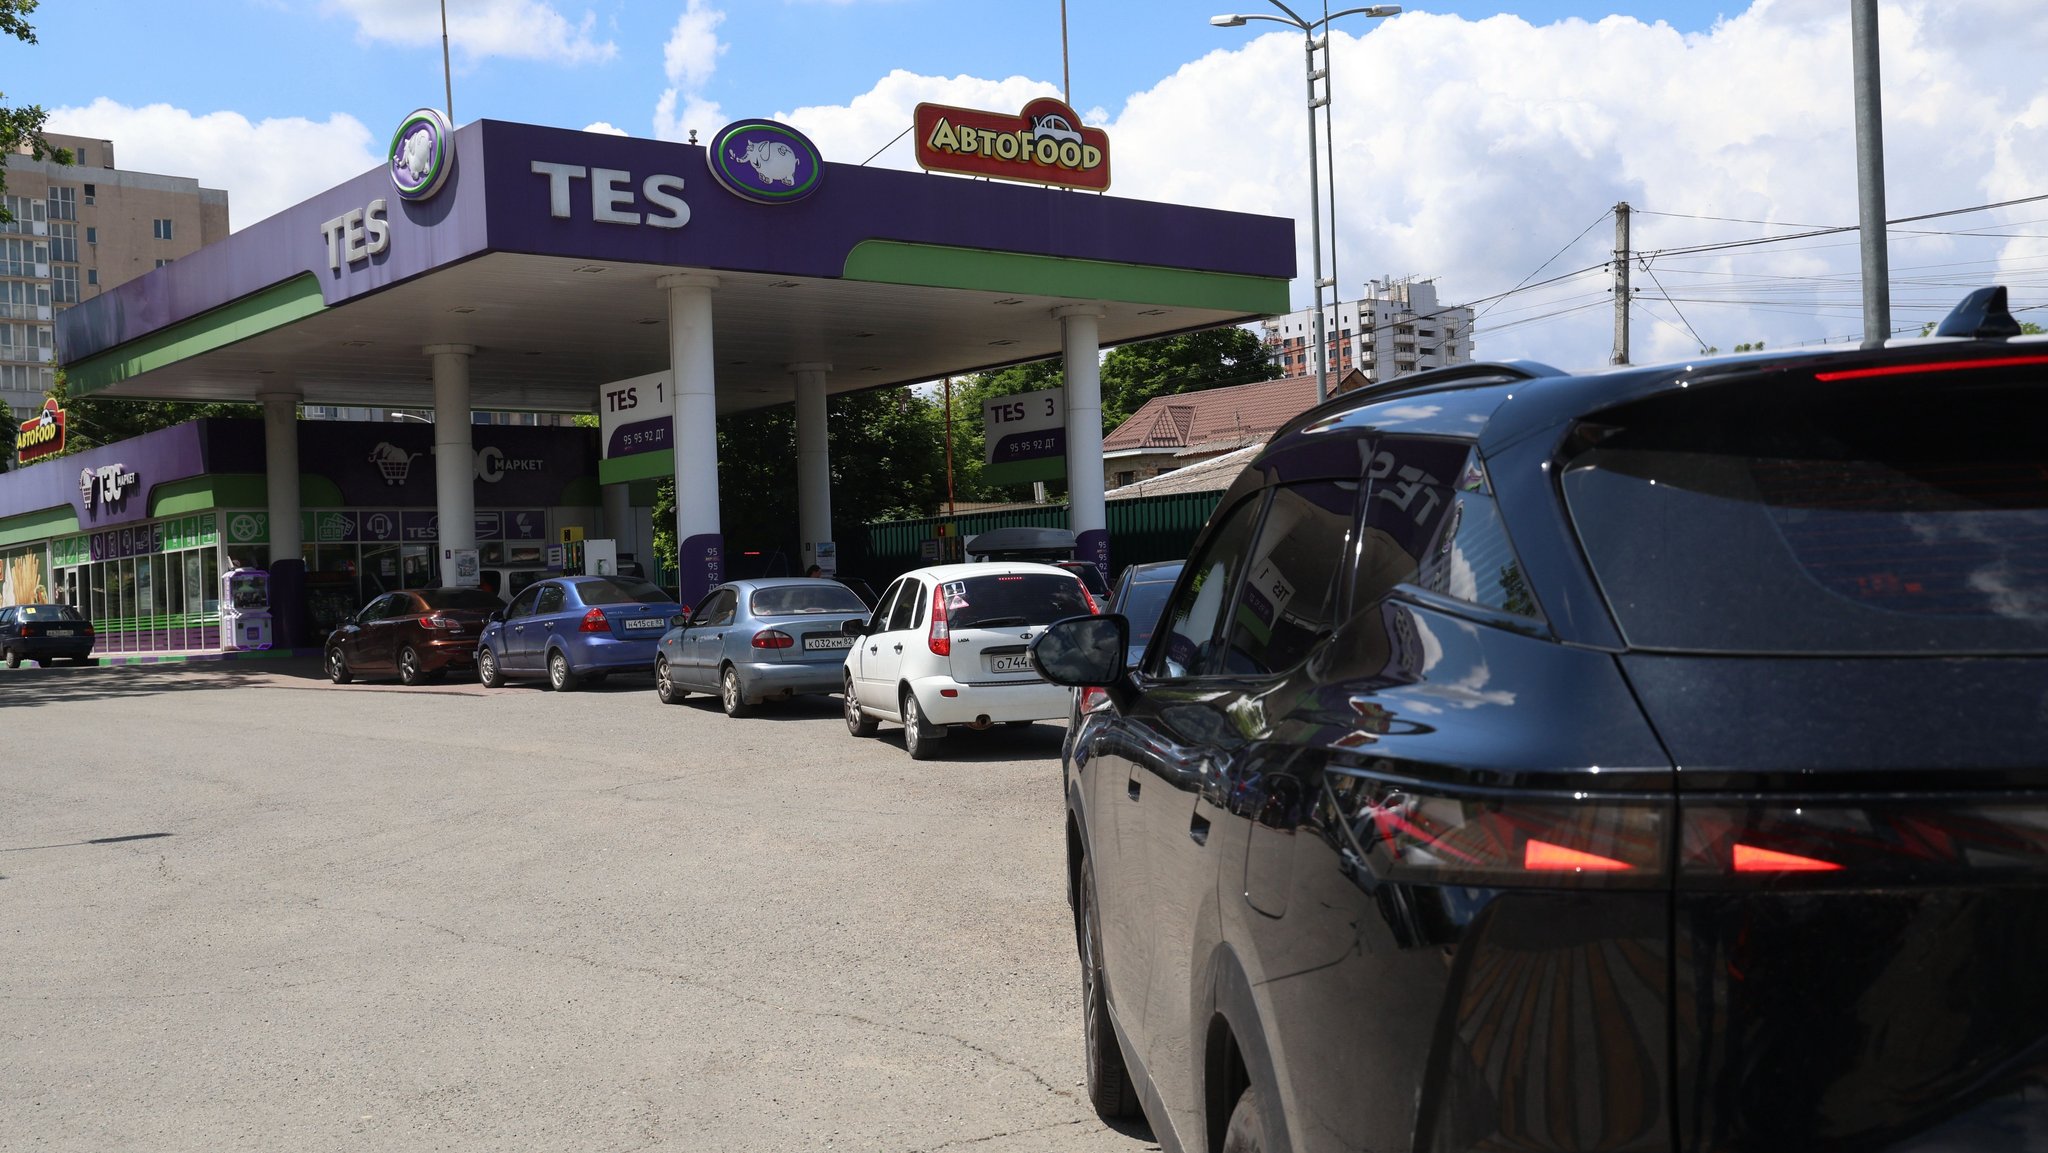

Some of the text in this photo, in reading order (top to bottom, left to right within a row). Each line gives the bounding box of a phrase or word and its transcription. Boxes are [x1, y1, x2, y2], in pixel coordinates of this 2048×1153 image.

[531, 160, 691, 229] TES
[321, 198, 390, 270] TES
[607, 382, 663, 412] TES 1
[990, 398, 1054, 424] TES 3
[623, 428, 665, 445] 95 95 92 ДТ
[1010, 438, 1055, 452] 95 95 92 ДТ
[495, 459, 543, 471] МАРКЕТ
[97, 463, 123, 504] ТЭС
[1098, 541, 1107, 549] 95
[707, 547, 718, 556] 95
[1098, 553, 1107, 561] 95
[707, 562, 718, 570] 95
[1099, 562, 1107, 570] 92
[708, 572, 719, 581] 92
[808, 639, 842, 648] К032КМ
[997, 656, 1032, 669] О744
